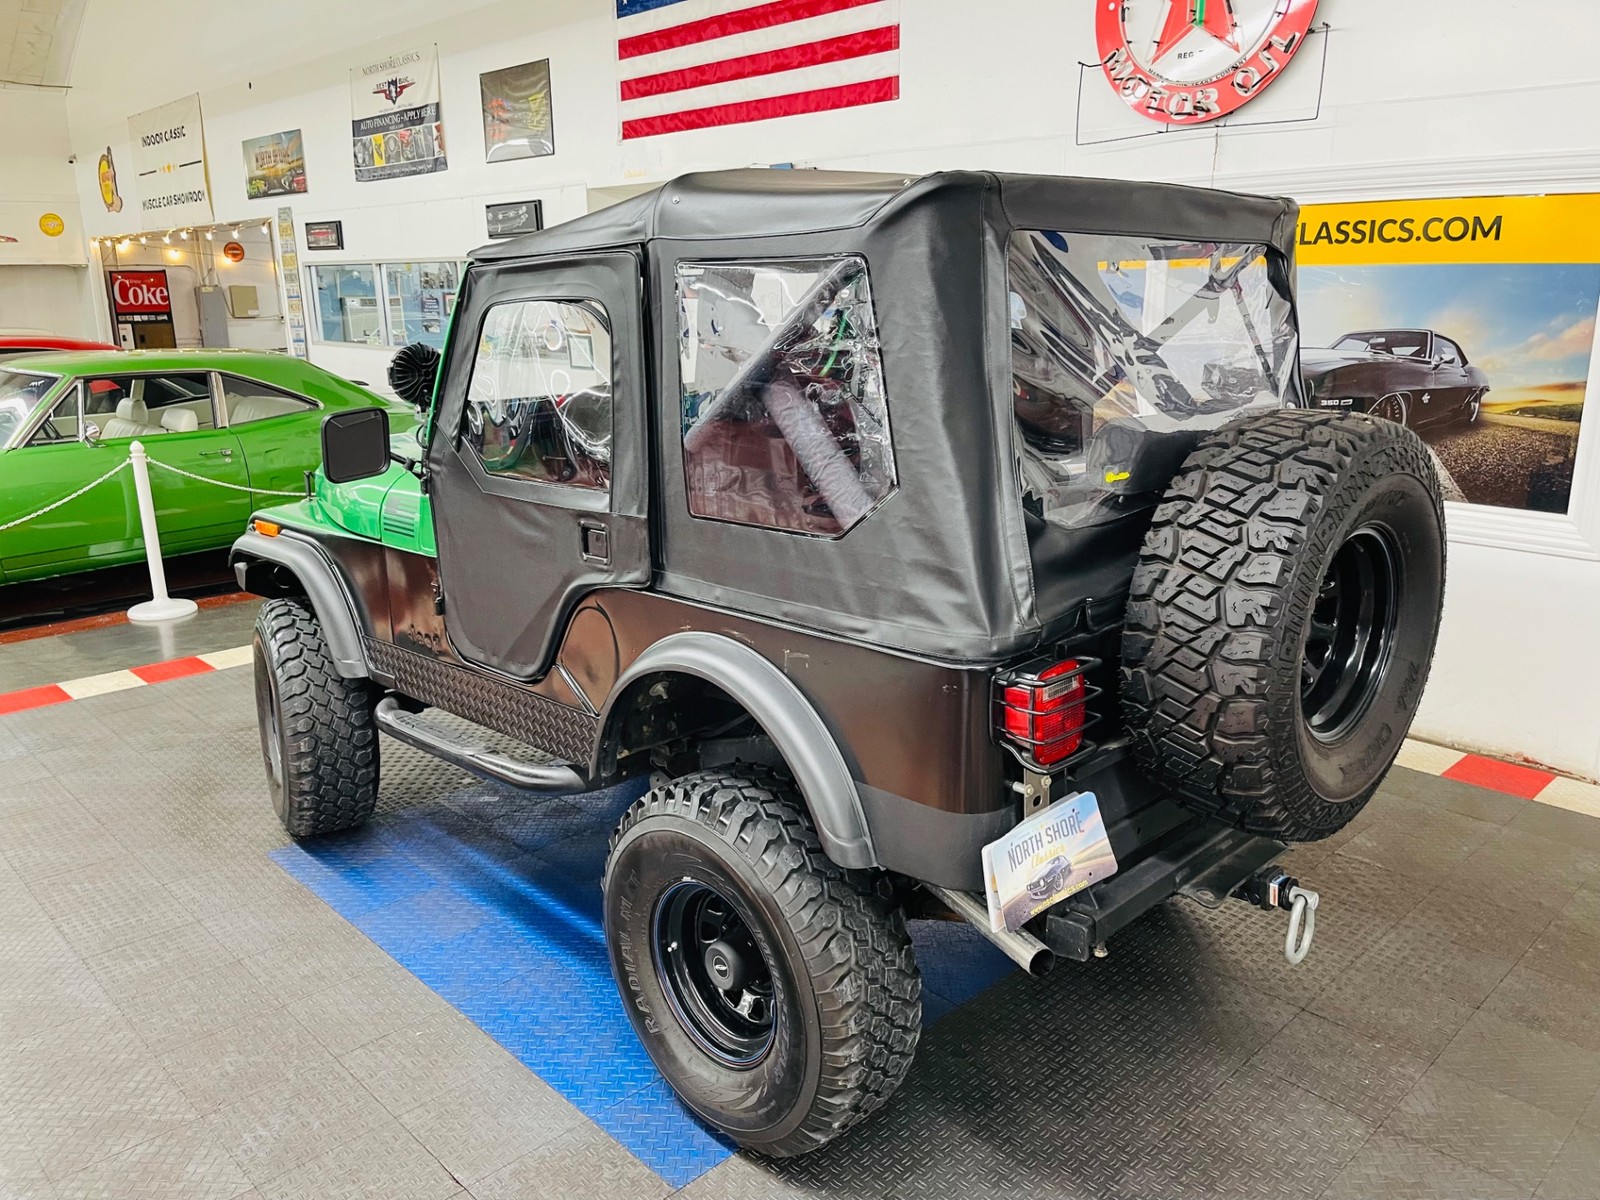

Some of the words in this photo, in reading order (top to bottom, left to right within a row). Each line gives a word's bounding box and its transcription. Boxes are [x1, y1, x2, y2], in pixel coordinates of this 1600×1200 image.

[1103, 47, 1221, 120] MOTOR
[1234, 32, 1301, 97] OIL
[1216, 56, 1248, 80] COMPNY
[360, 120, 374, 131] AUTO
[374, 113, 400, 127] FINANCING
[404, 109, 420, 121] APPLY
[421, 105, 437, 118] HERE
[141, 132, 164, 148] INDOOR
[164, 125, 187, 142] CLASSIC
[142, 197, 162, 211] MUSCLE
[162, 195, 174, 208] CAR
[1297, 215, 1503, 246] LASSICS.COM
[113, 278, 169, 306] Coke
[1007, 831, 1044, 873] NORTH
[1044, 811, 1085, 845] SHORE
[619, 931, 661, 1035] RADIAL
